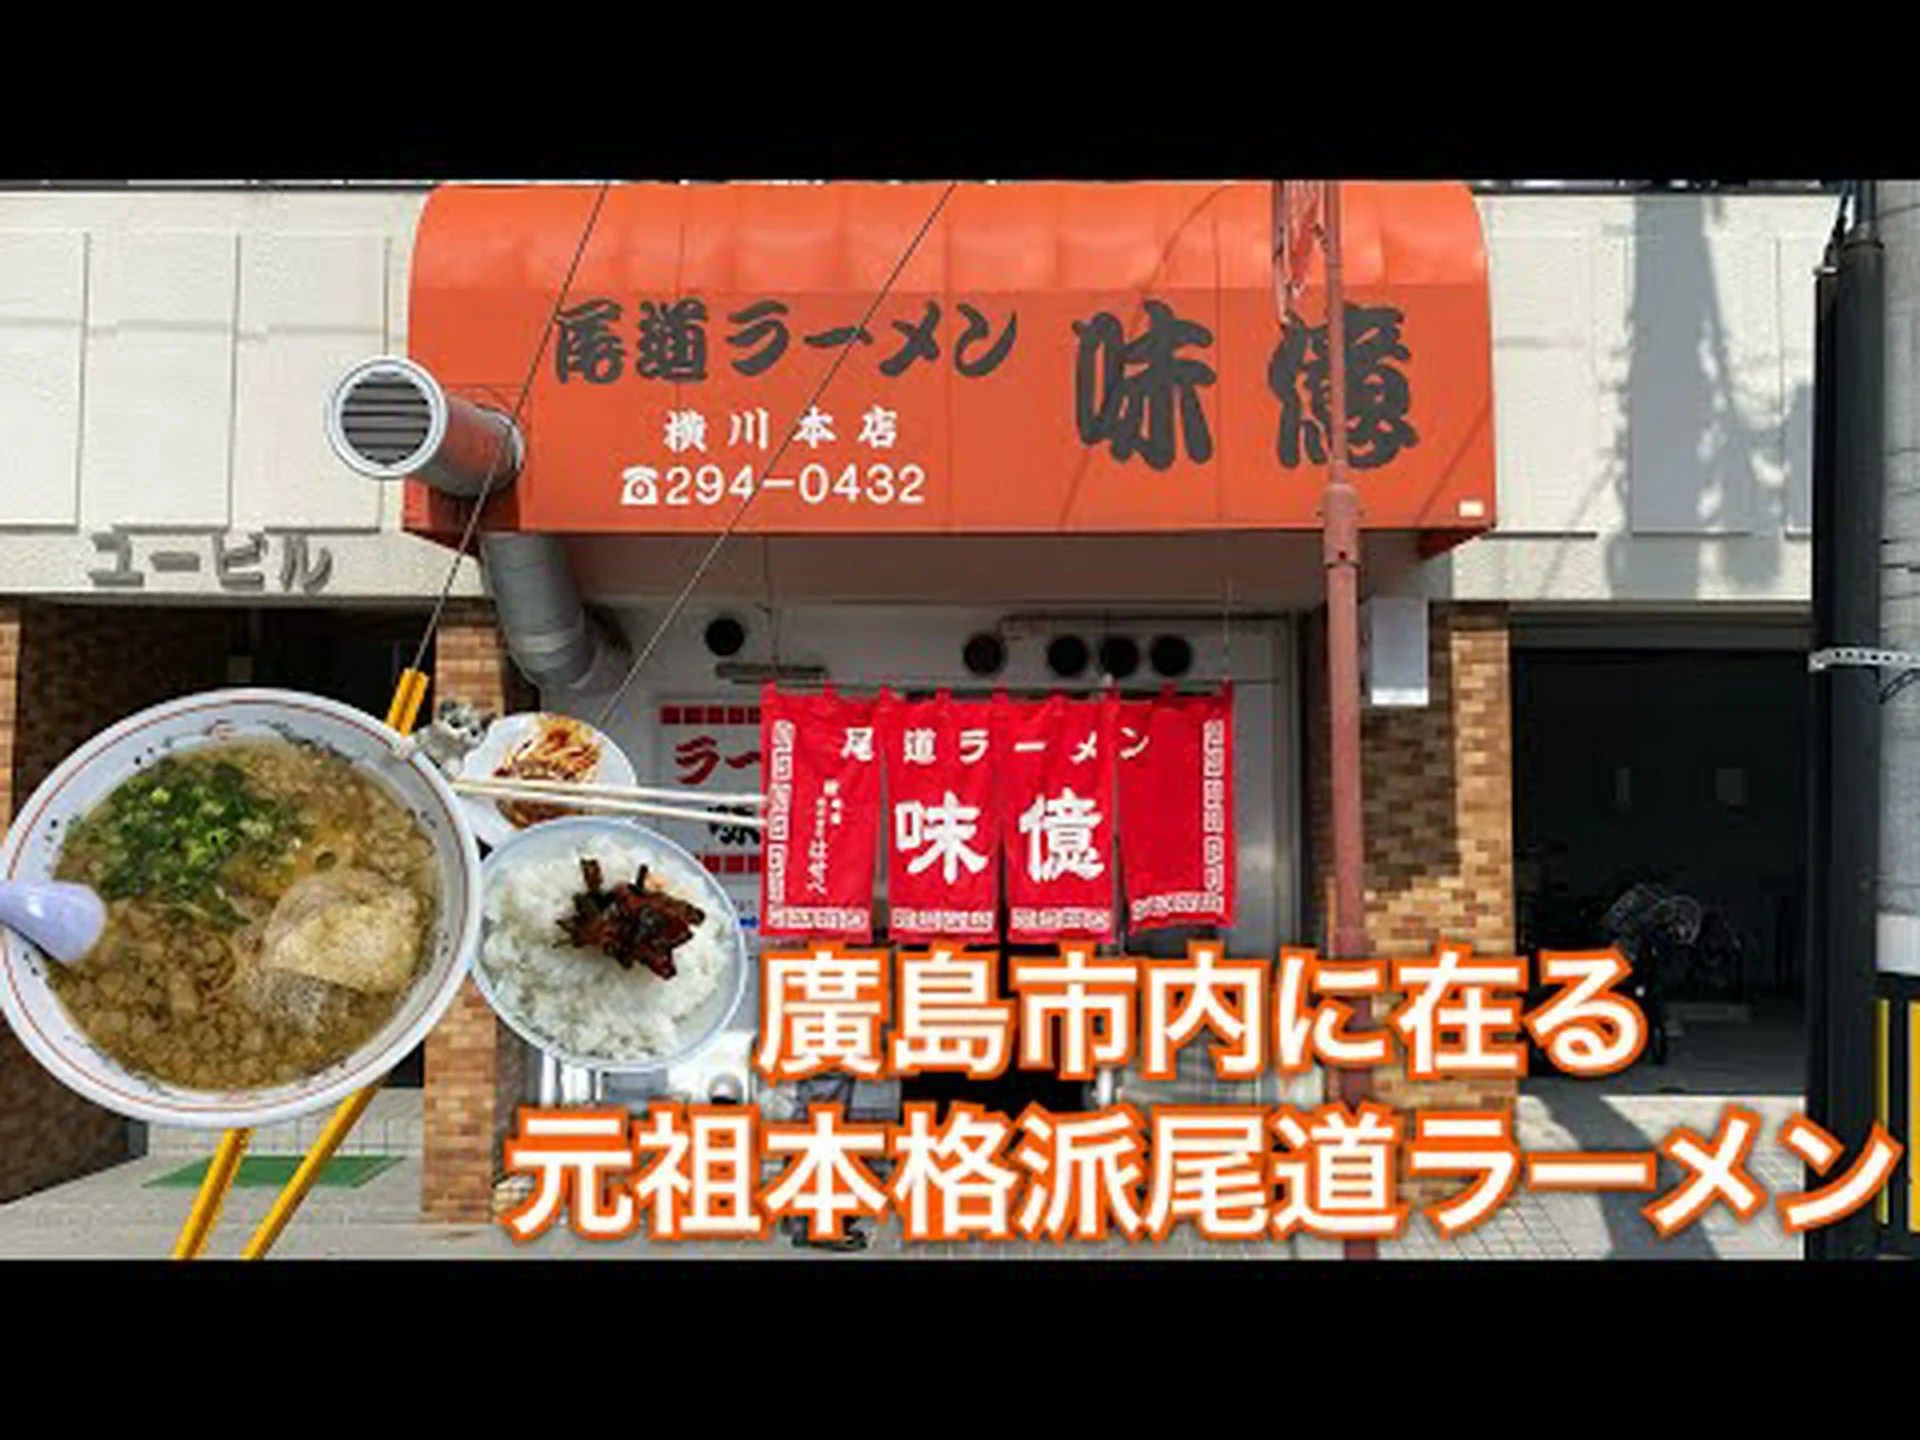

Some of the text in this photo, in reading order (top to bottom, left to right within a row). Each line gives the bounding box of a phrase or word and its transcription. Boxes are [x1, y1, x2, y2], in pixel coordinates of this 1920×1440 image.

[555, 299, 1018, 385] 尾道ラーメン
[1072, 299, 1419, 471] 味億
[662, 405, 899, 452] 横川本店
[664, 463, 926, 505] 294-0432
[88, 531, 333, 595] ユービル
[840, 726, 1150, 764] 尾道ラーメン
[894, 786, 1104, 885] 味億
